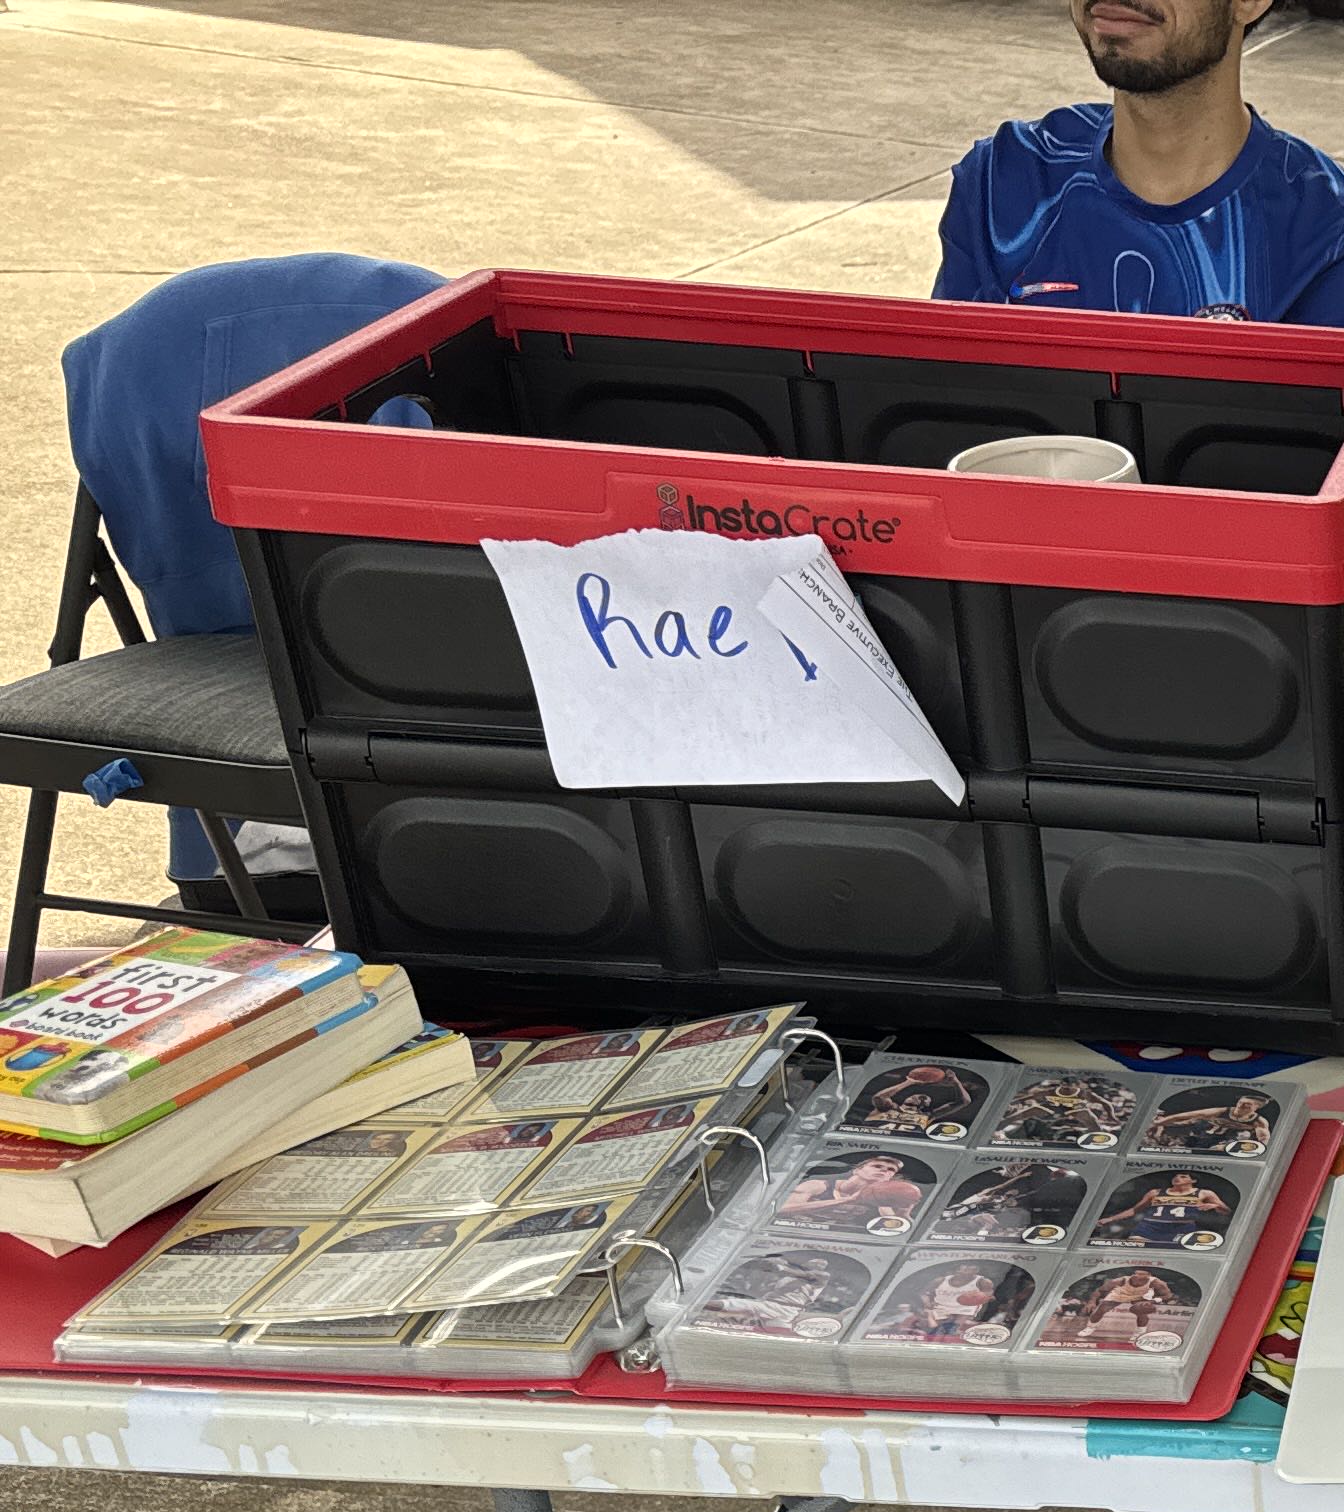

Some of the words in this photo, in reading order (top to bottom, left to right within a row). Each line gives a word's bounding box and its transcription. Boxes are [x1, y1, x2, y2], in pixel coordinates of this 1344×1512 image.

[575, 571, 749, 670] Rae
[843, 618, 896, 680] EXECUTIVE
[115, 963, 217, 993] first
[59, 980, 175, 1015] 100
[24, 1020, 68, 1037] board
[66, 1024, 104, 1042] book
[39, 1007, 129, 1030] words
[1152, 1205, 1187, 1219] 14
